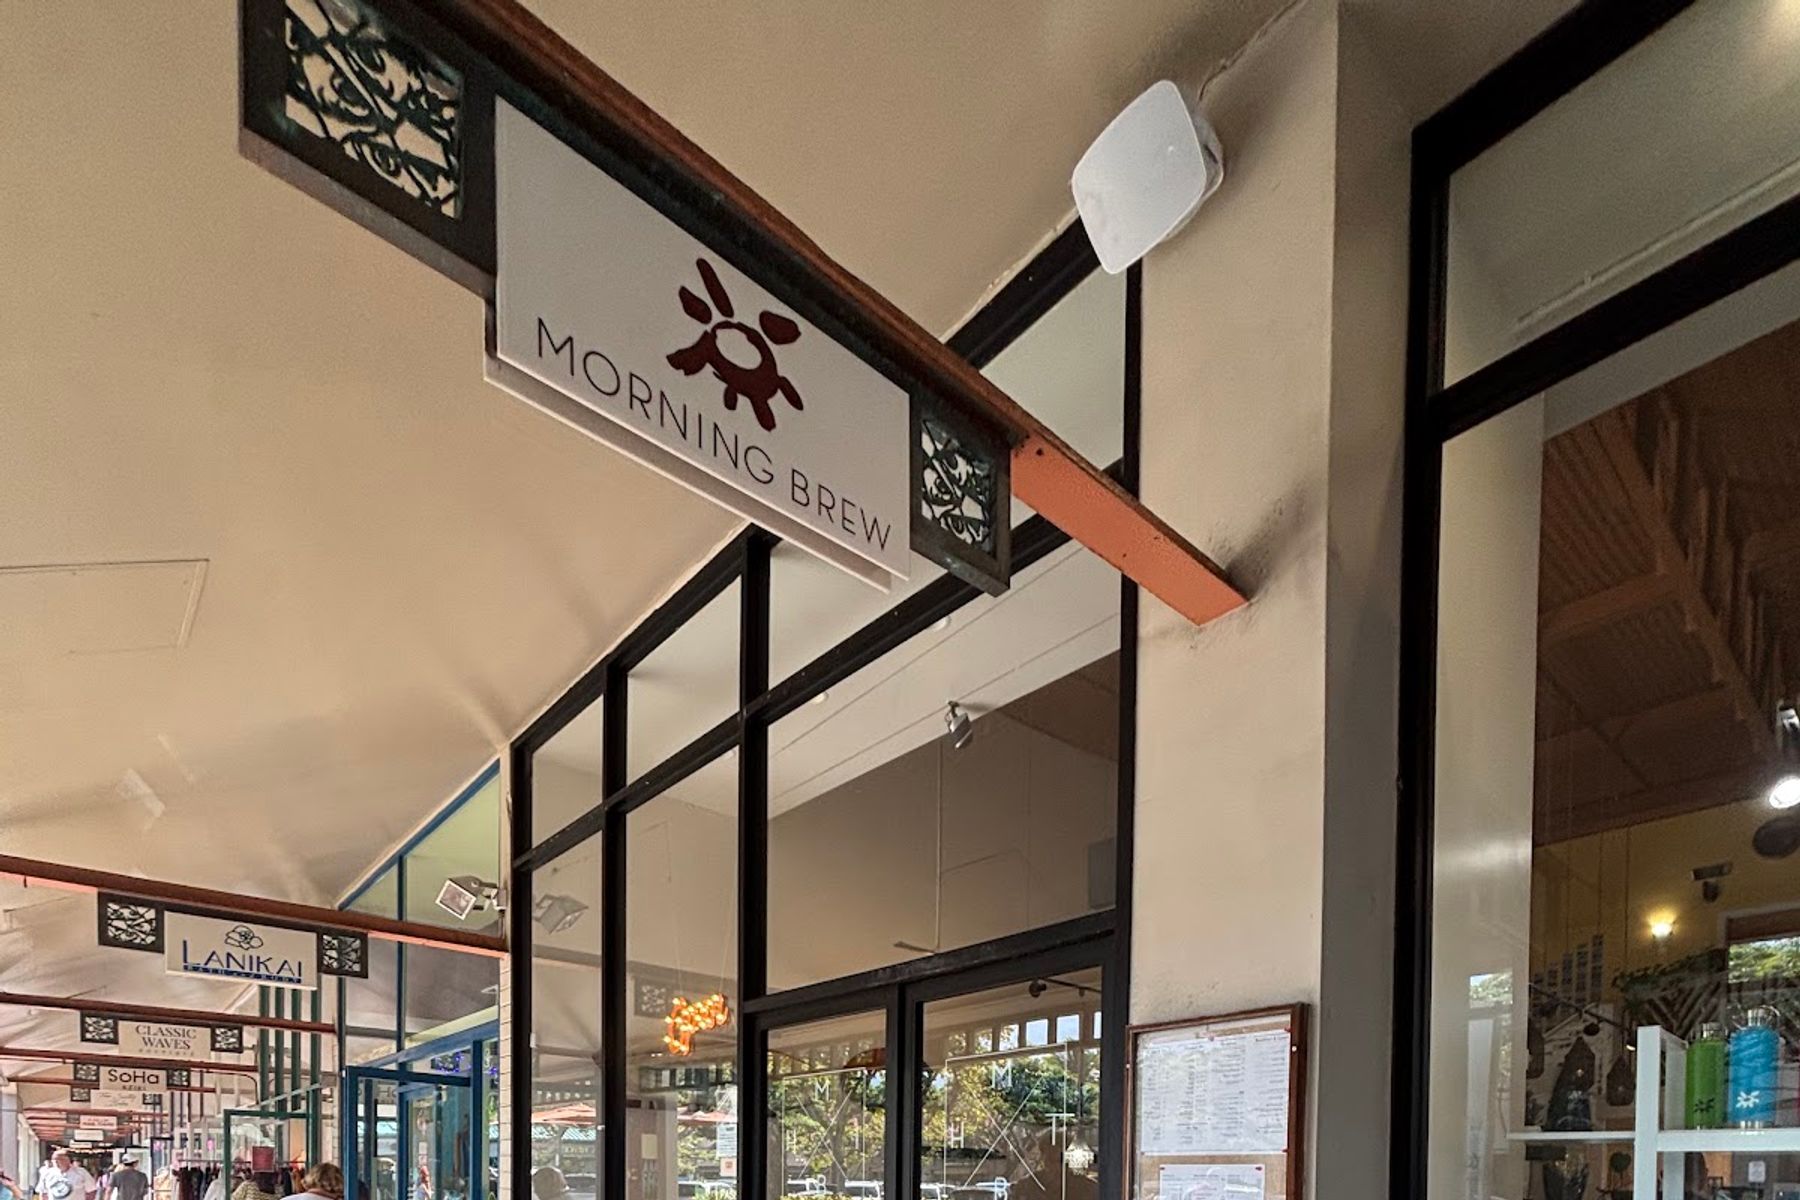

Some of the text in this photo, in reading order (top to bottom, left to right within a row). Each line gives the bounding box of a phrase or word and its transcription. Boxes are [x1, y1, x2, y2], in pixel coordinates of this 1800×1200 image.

[536, 317, 892, 551] MORNING BREW
[182, 940, 302, 977] LANIKAI
[135, 1024, 197, 1040] CLASSIC
[142, 1036, 191, 1050] WAVES
[107, 1068, 160, 1085] SoHa
[991, 1062, 1013, 1089] M
